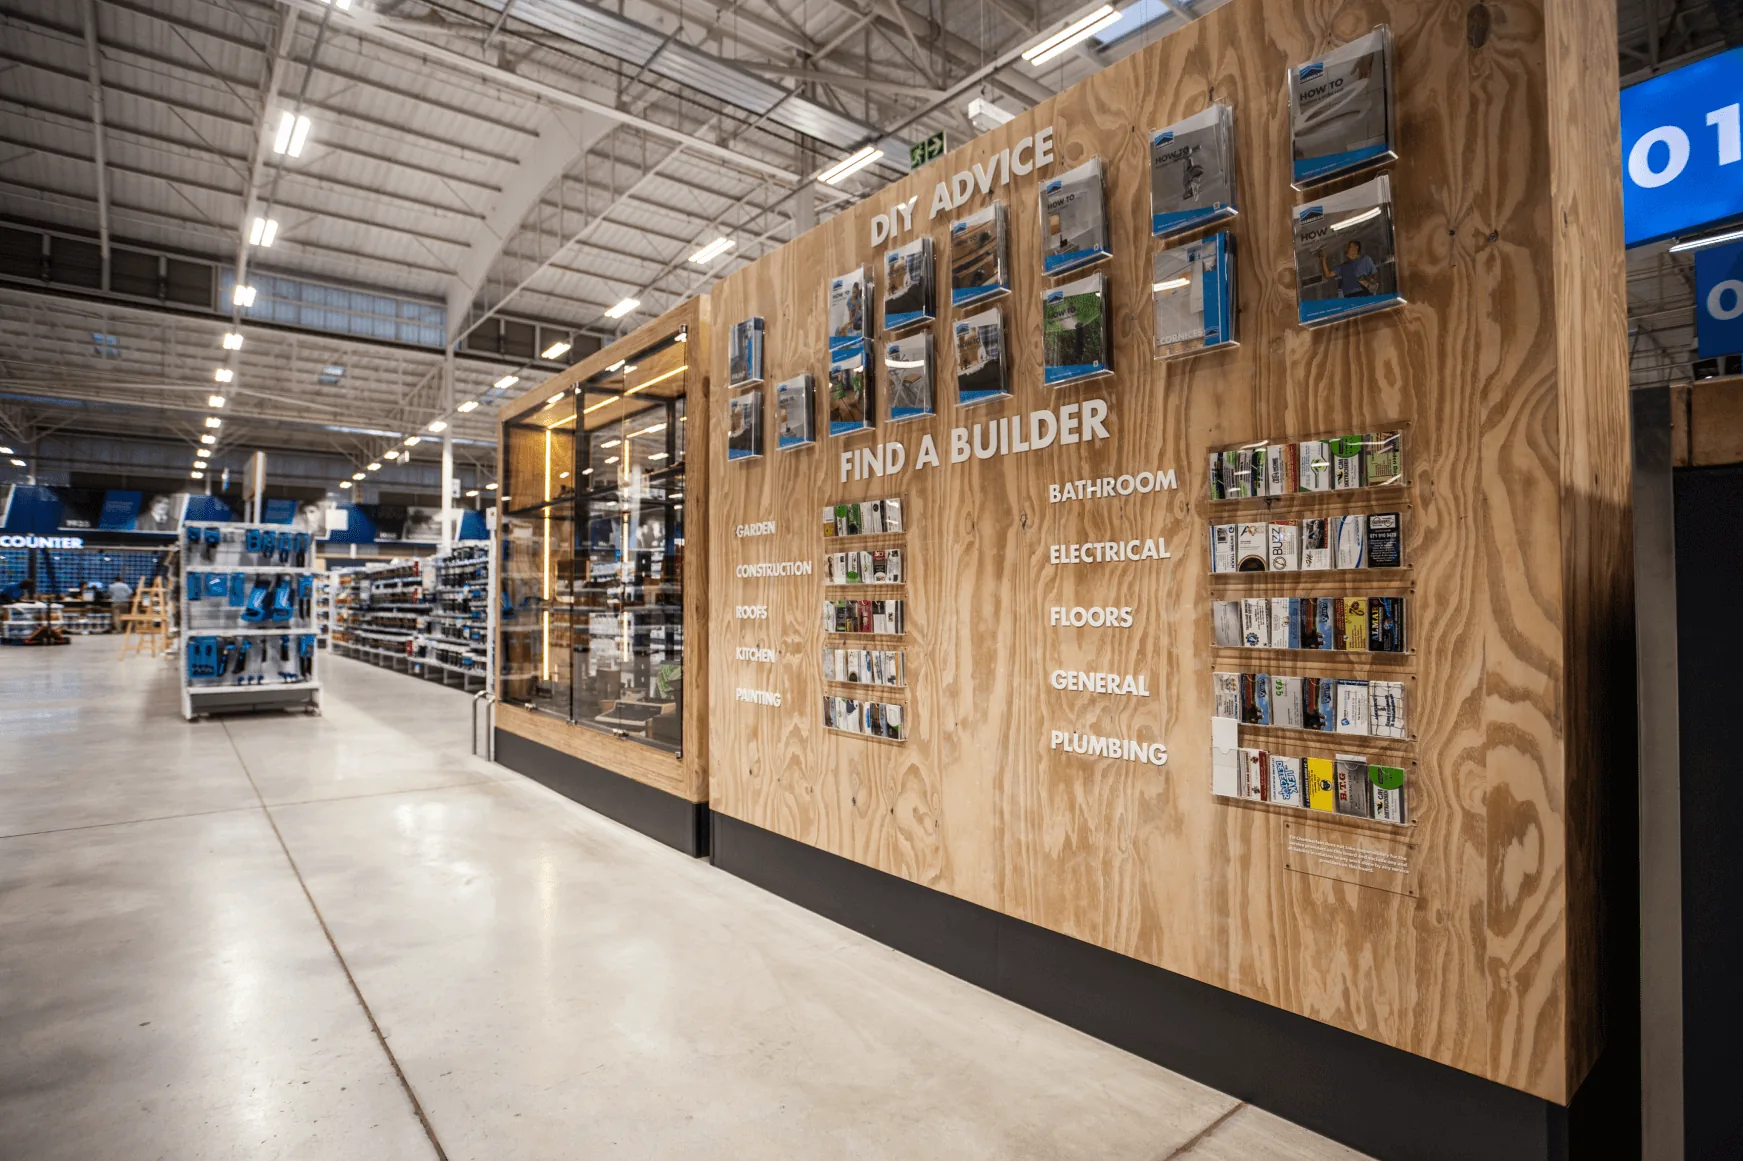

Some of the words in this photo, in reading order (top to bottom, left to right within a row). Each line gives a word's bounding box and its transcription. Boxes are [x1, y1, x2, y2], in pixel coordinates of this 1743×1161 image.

[1300, 85, 1327, 100] HOW
[1329, 78, 1344, 90] TO
[1156, 150, 1178, 164] HOW
[1179, 146, 1190, 155] TO
[1628, 102, 1742, 188] 01
[871, 195, 918, 248] DIY
[928, 126, 1054, 220] ADVICE
[1048, 198, 1064, 210] HOW
[1066, 194, 1075, 203] TO
[1300, 227, 1328, 242] HOW
[840, 442, 906, 483] FIND
[915, 434, 940, 470] A
[951, 398, 1110, 464] BUILDER
[1050, 469, 1178, 503] BATHROOM
[736, 520, 776, 538] GARDEN
[0, 535, 84, 549] COUNTER
[1050, 538, 1171, 565] ELECTRICAL
[1272, 528, 1283, 556] BUZZ
[736, 560, 812, 578] CONSTRUCTION
[736, 605, 768, 620] ROOFS
[1050, 606, 1133, 628] FLOORS
[736, 648, 776, 663] KITCHEN
[1051, 670, 1150, 696] GENERAL
[736, 687, 782, 708] PAINTING
[1051, 730, 1168, 766] PLUMBING
[1276, 760, 1291, 800] DETECTOR
[1284, 770, 1298, 795] LEAK
[1339, 772, 1348, 801] B.T.G
